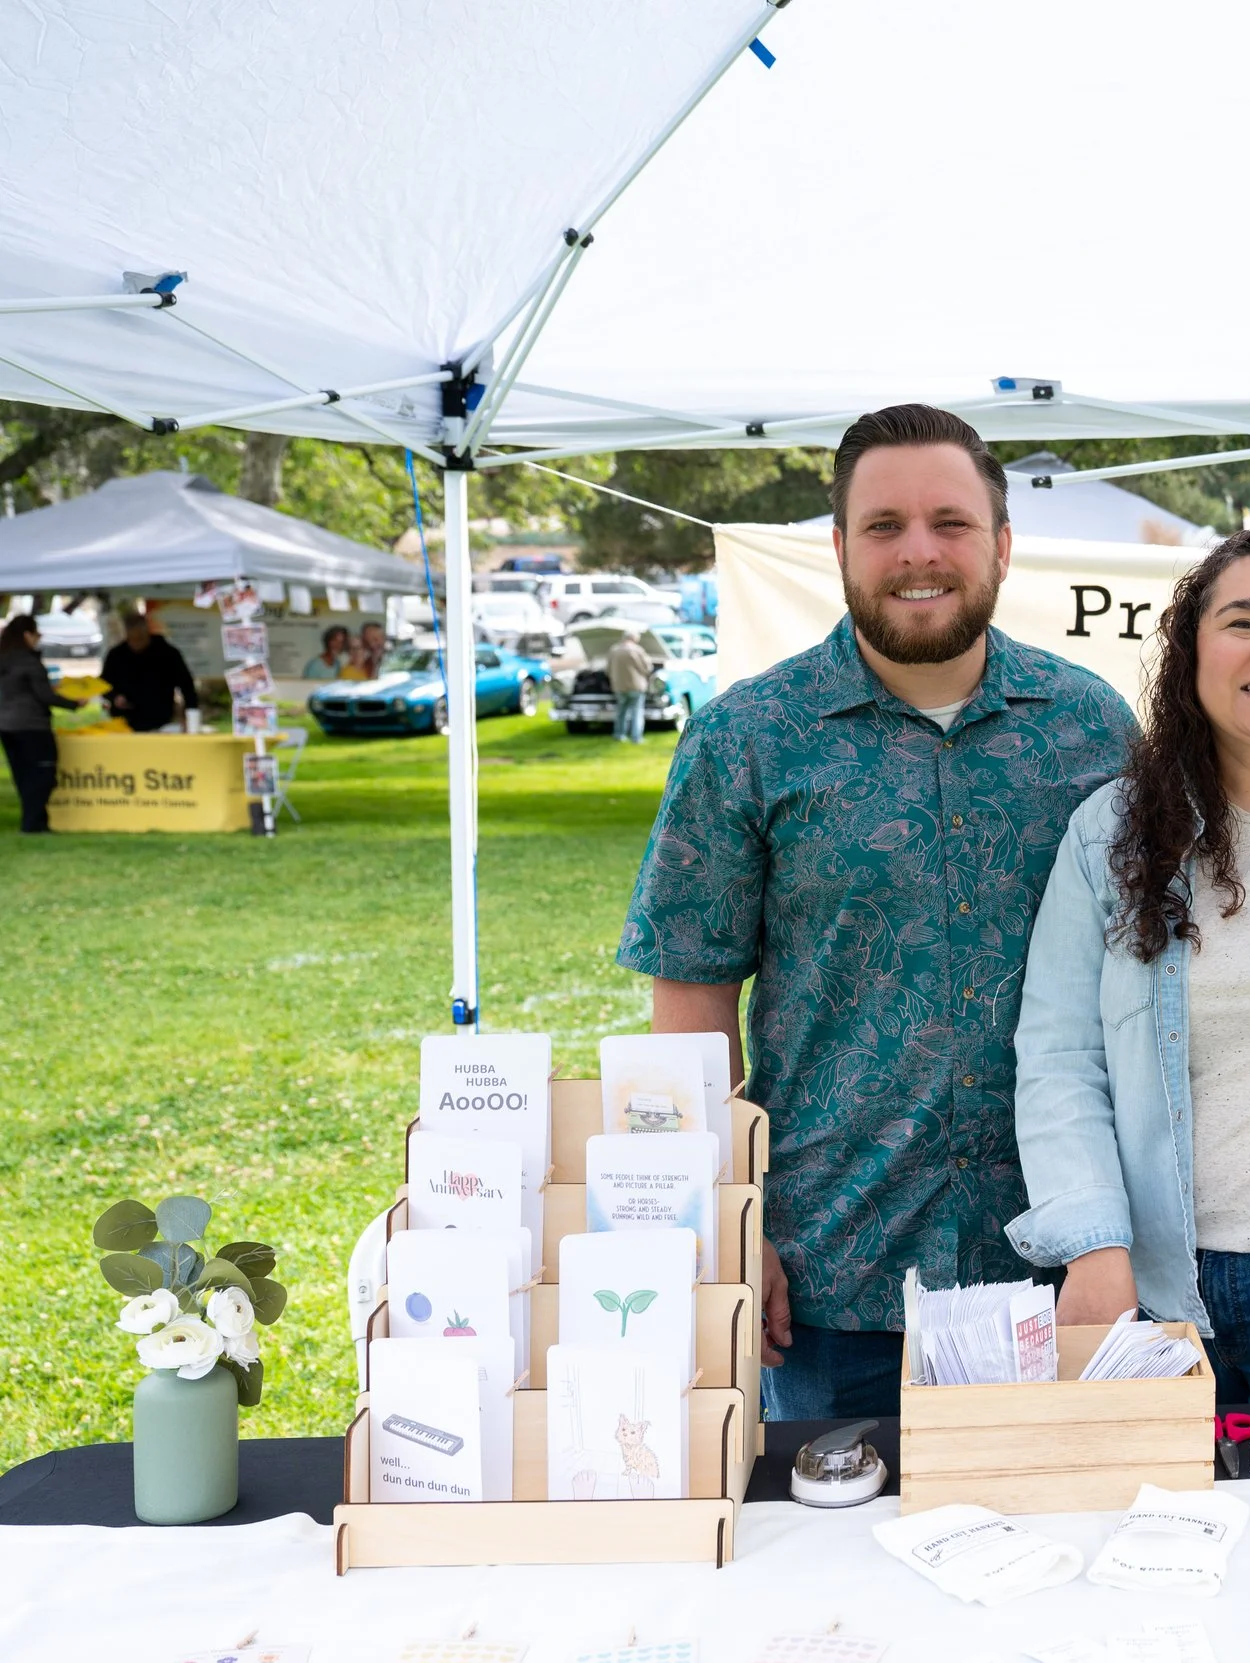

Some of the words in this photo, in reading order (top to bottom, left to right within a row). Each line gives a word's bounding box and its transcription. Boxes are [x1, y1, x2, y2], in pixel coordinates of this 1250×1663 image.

[57, 766, 136, 796] hining
[144, 768, 196, 791] Star
[454, 1064, 496, 1074] HUBBA
[466, 1077, 507, 1087] HUBBA
[439, 1092, 528, 1111] AooOO!
[429, 1178, 503, 1200] Anniversary
[444, 1170, 484, 1189] Happy
[1019, 1326, 1052, 1352] BECAUSE
[380, 1456, 411, 1469] well...
[382, 1472, 402, 1485] dun
[404, 1476, 425, 1489] dun
[427, 1480, 448, 1493] dun
[450, 1484, 471, 1496] dun
[1178, 1516, 1218, 1529] HANKIES
[924, 1536, 950, 1552] HAND
[968, 1520, 1006, 1534] HANKIES
